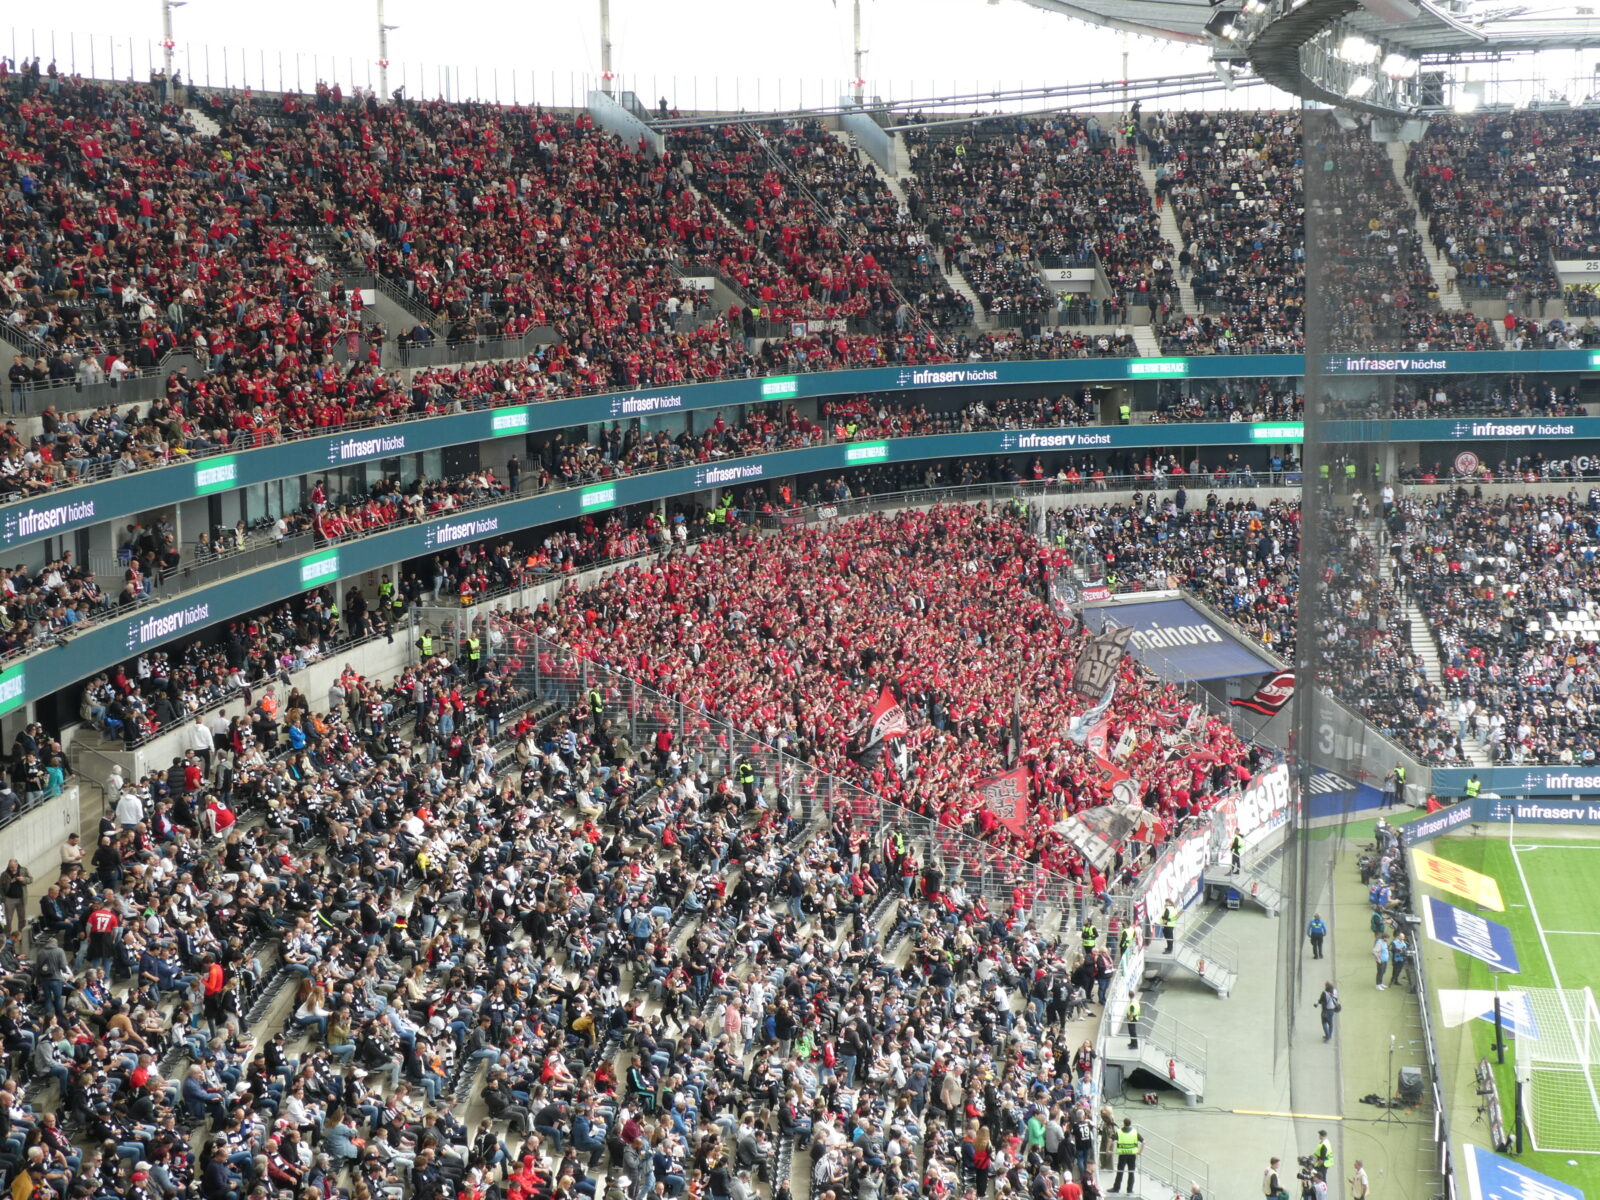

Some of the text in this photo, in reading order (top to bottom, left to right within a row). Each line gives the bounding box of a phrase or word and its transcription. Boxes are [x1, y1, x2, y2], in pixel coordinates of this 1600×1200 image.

[1060, 270, 1072, 279] 23
[1586, 262, 1599, 271] 25
[1347, 357, 1447, 371] infraserv höchst
[914, 370, 997, 384] infraserv höchst
[622, 396, 682, 414] infraserv höchst
[1473, 423, 1575, 437] infraserv höchst
[341, 436, 405, 460] infraserv höchst
[1019, 434, 1111, 448] infraserv höchst
[705, 465, 763, 484] infraserv höchst
[18, 501, 95, 537] infraserv höchst
[436, 518, 498, 544] infraserv höchst
[139, 602, 209, 643] infraserv höchst
[1130, 622, 1223, 650] mainova
[1318, 723, 1334, 755] 3
[62, 807, 71, 827] 16
[1517, 804, 1584, 819] infraserv
[1416, 806, 1472, 837] infraserv höchst
[97, 917, 110, 930] 17
[1080, 1126, 1090, 1138] 19
